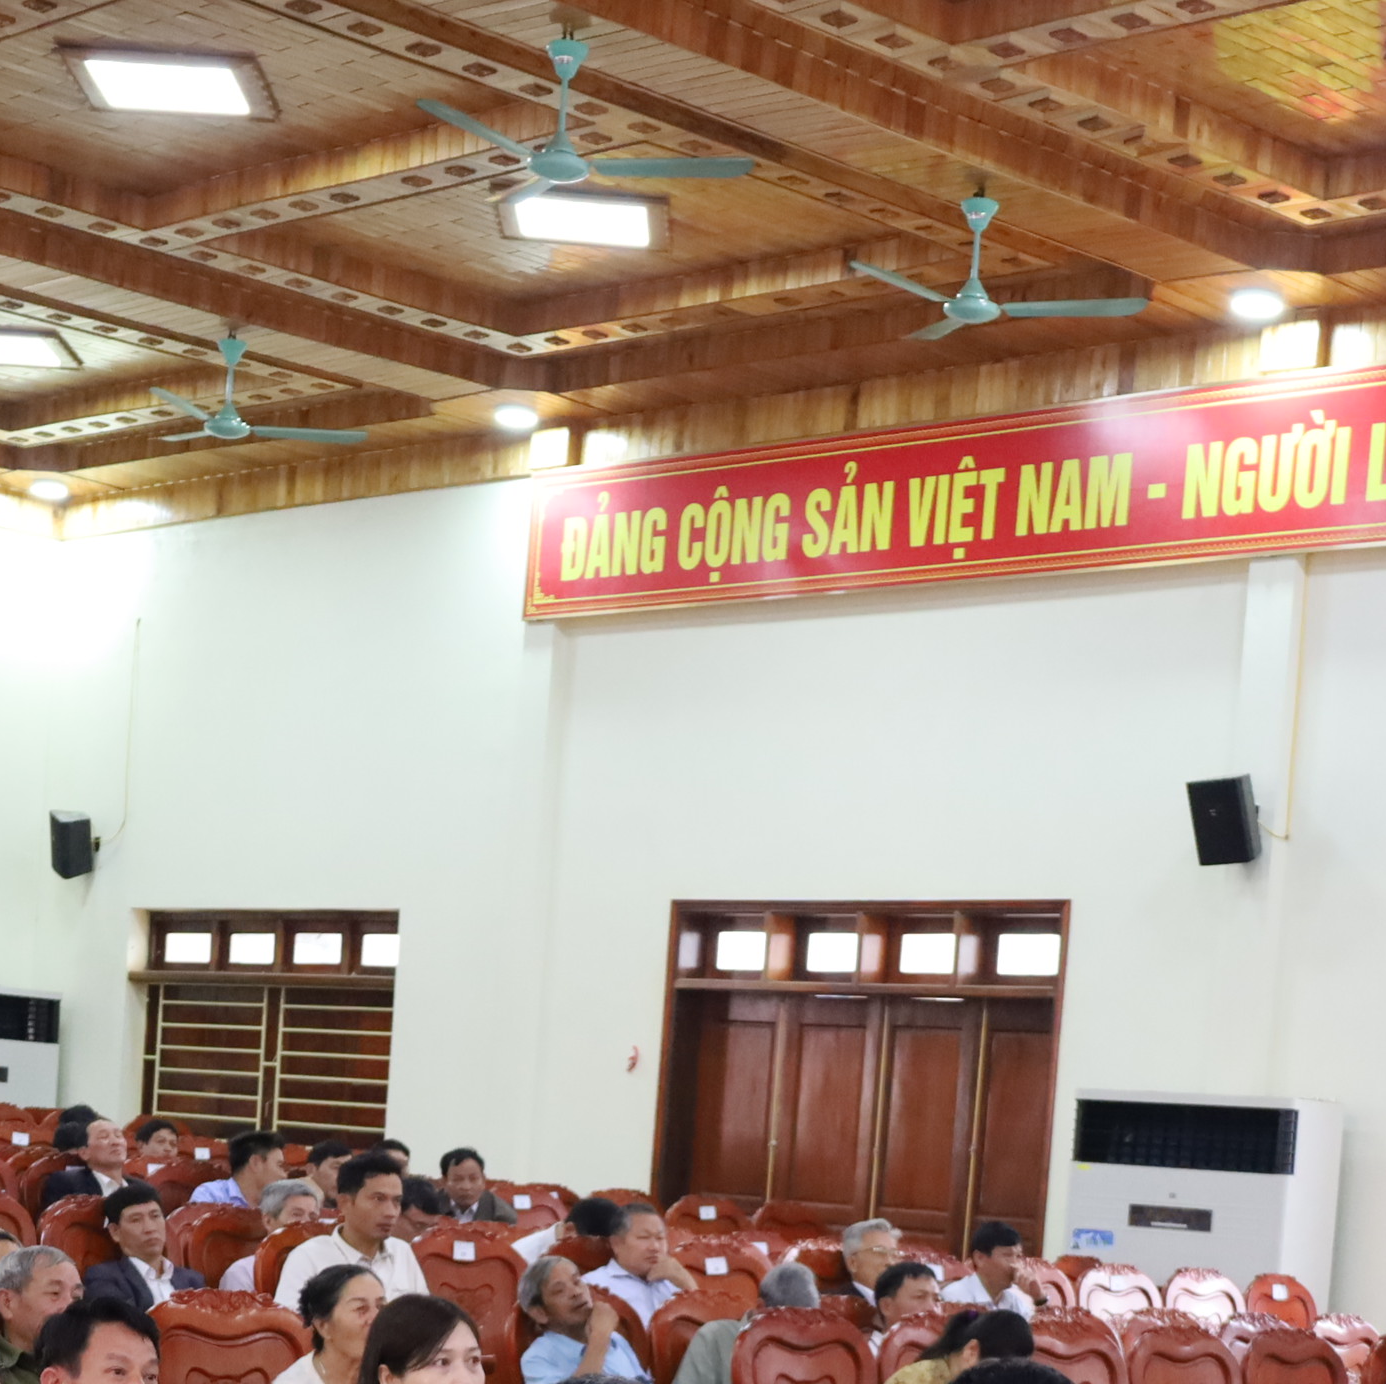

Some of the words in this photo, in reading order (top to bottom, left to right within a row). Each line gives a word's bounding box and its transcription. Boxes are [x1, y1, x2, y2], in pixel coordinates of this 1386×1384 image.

[560, 490, 668, 581] ĐẢNG
[677, 486, 791, 583] CỘNG
[801, 461, 896, 558] SẢN
[909, 455, 1006, 560] VIỆT
[1016, 453, 1132, 537] NAM
[1182, 407, 1353, 519] NGƯỜI
